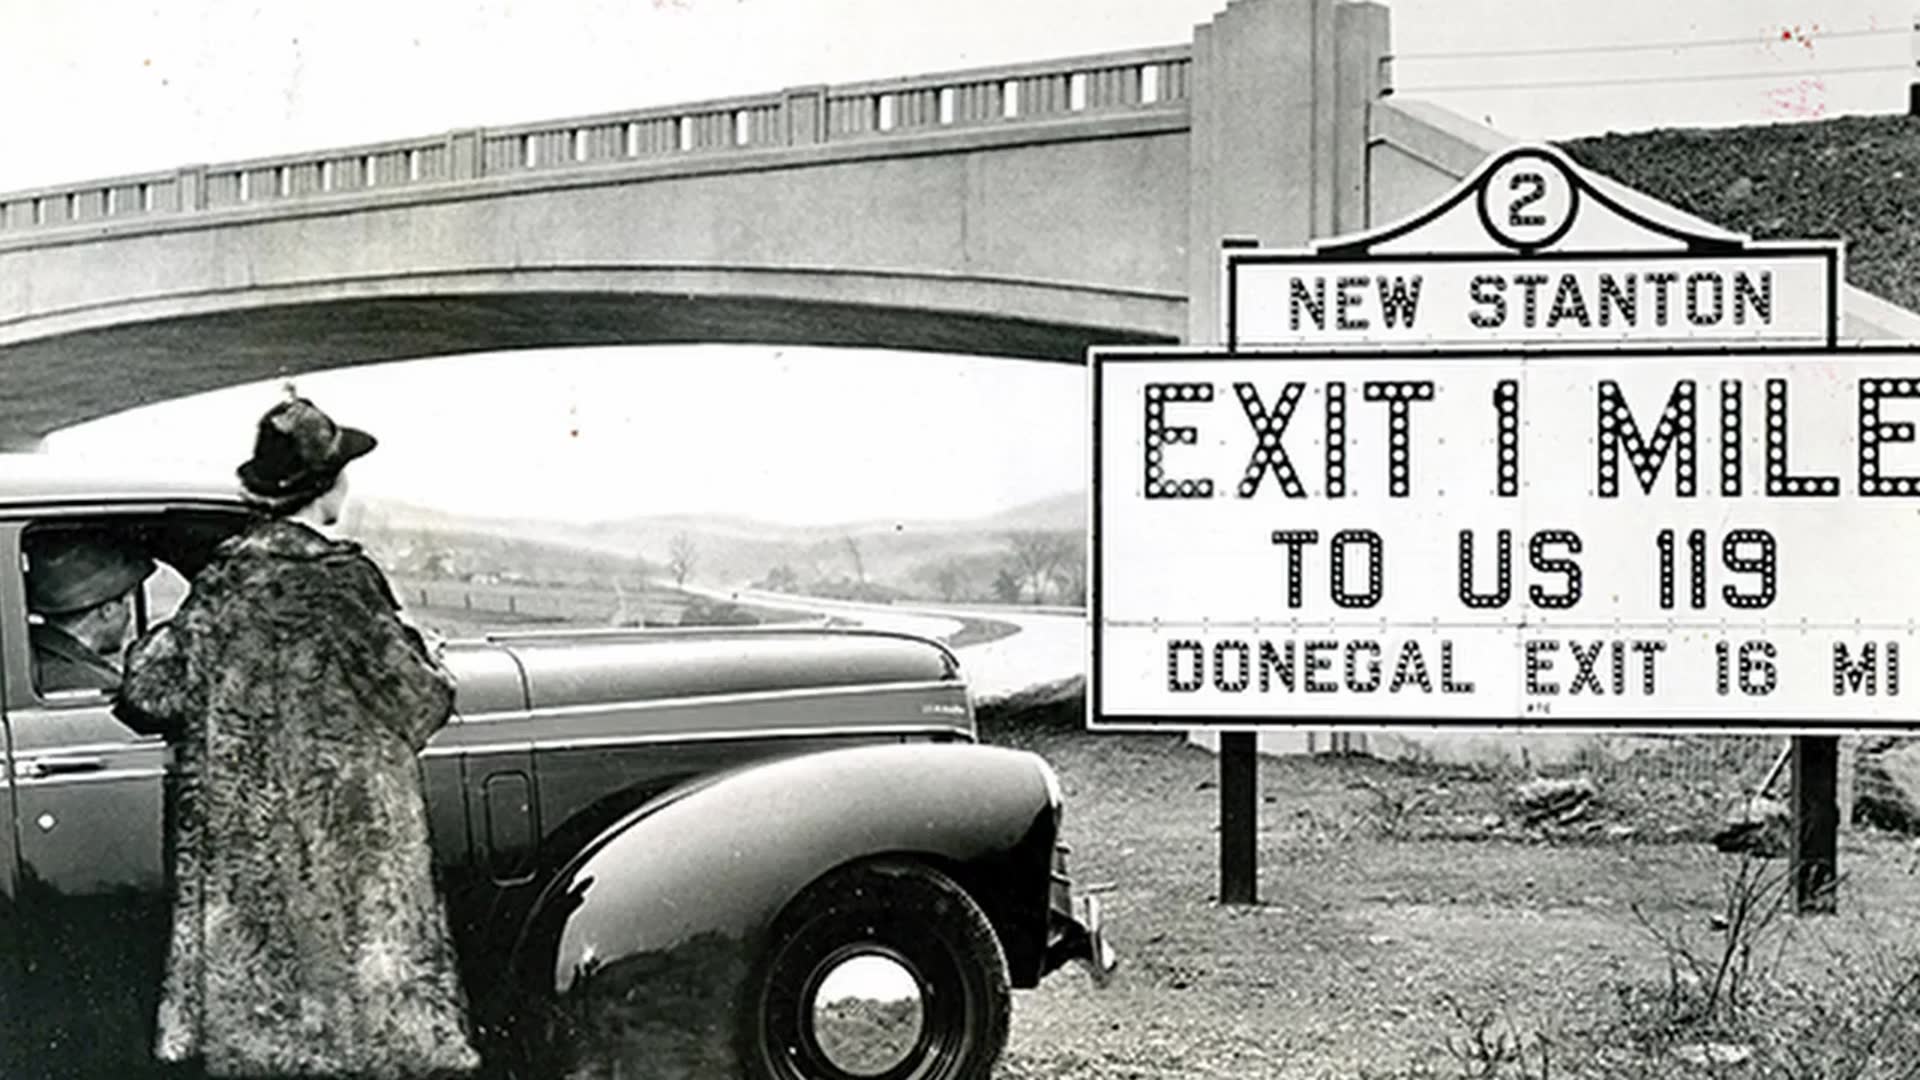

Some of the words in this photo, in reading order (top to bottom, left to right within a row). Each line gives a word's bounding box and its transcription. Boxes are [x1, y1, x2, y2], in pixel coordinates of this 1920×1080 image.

[1509, 173, 1546, 227] 2
[1290, 276, 1423, 331] NEW
[1469, 272, 1771, 328] STANTON
[1144, 380, 1435, 500] EXIT
[1492, 379, 1517, 498] 1
[1597, 377, 1920, 499] MILE
[1271, 529, 1383, 609] TO
[1458, 529, 1583, 610] US
[1656, 528, 1777, 610] 119
[1168, 639, 1473, 694] DONEGAL
[1525, 640, 1666, 696] EXIT
[1715, 641, 1777, 696] 16
[1833, 642, 1899, 696] MI
